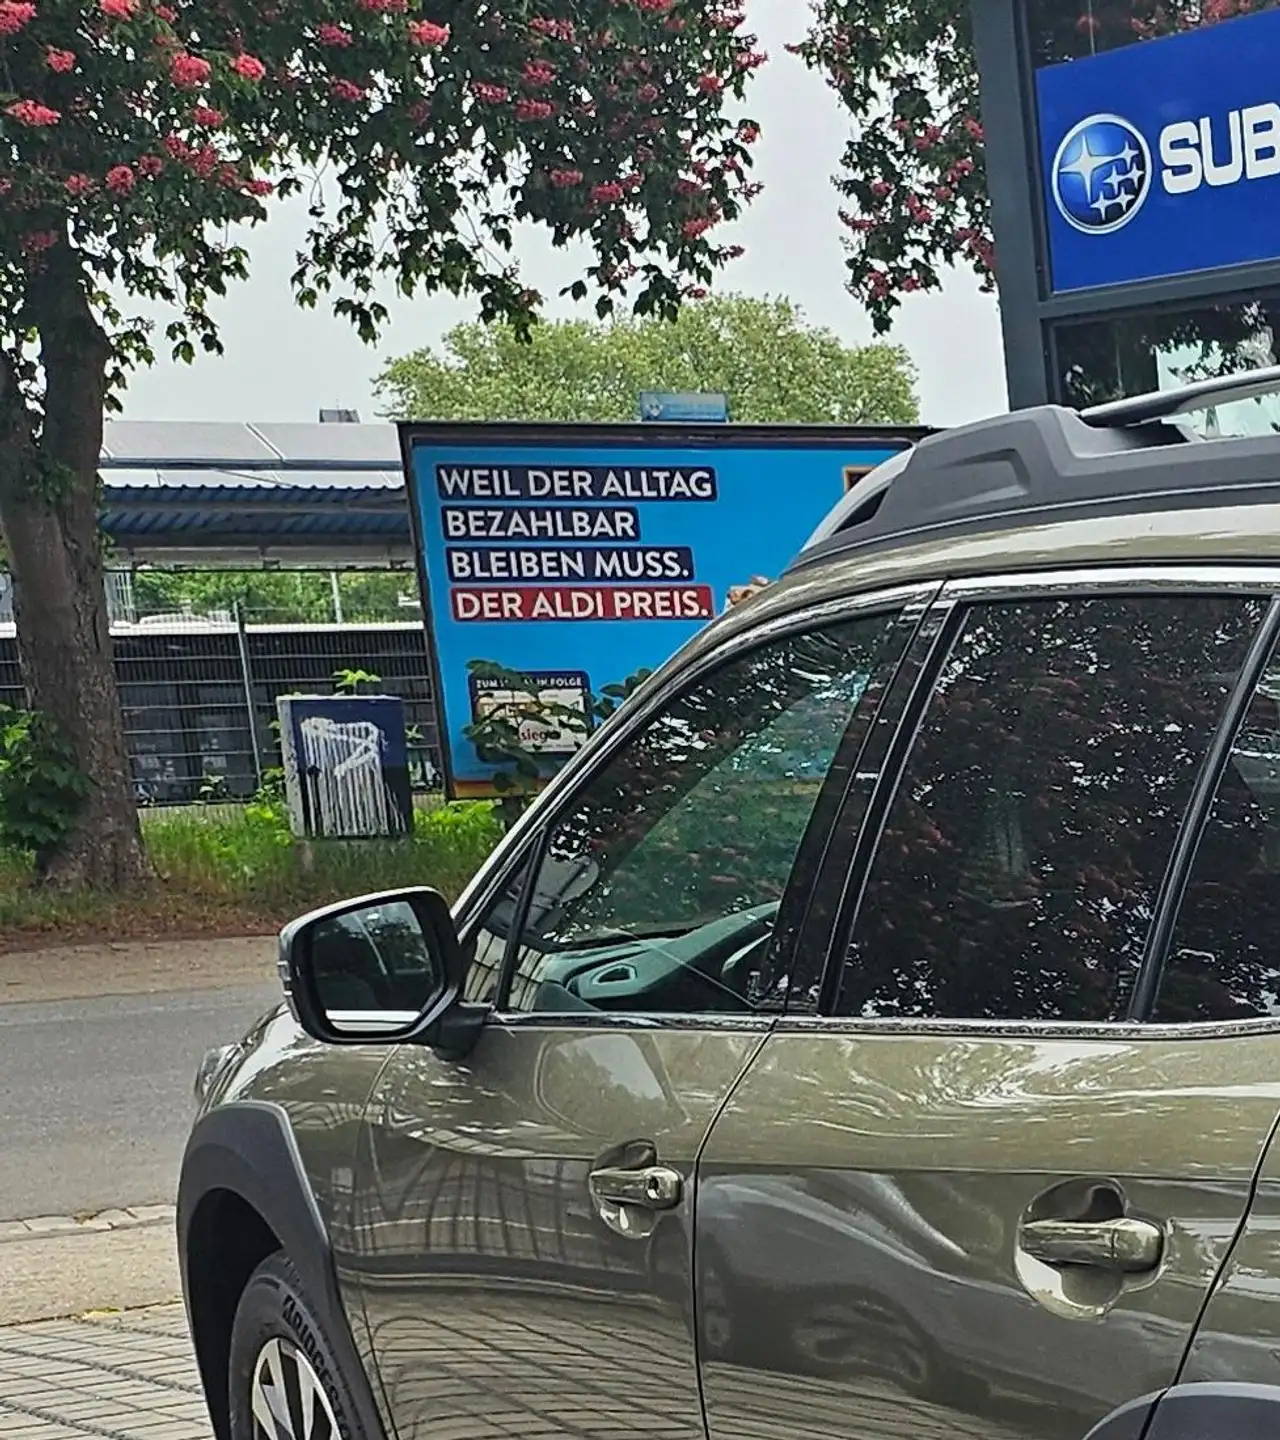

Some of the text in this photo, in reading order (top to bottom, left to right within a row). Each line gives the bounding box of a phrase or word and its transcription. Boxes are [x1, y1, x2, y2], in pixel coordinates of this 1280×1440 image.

[439, 469, 712, 498] WEIL DER ALLTAG
[446, 510, 636, 538] BEZAHLBAR
[451, 551, 689, 579] BLEIBEN MUSS.
[456, 590, 709, 619] DER ALDI PREIS.
